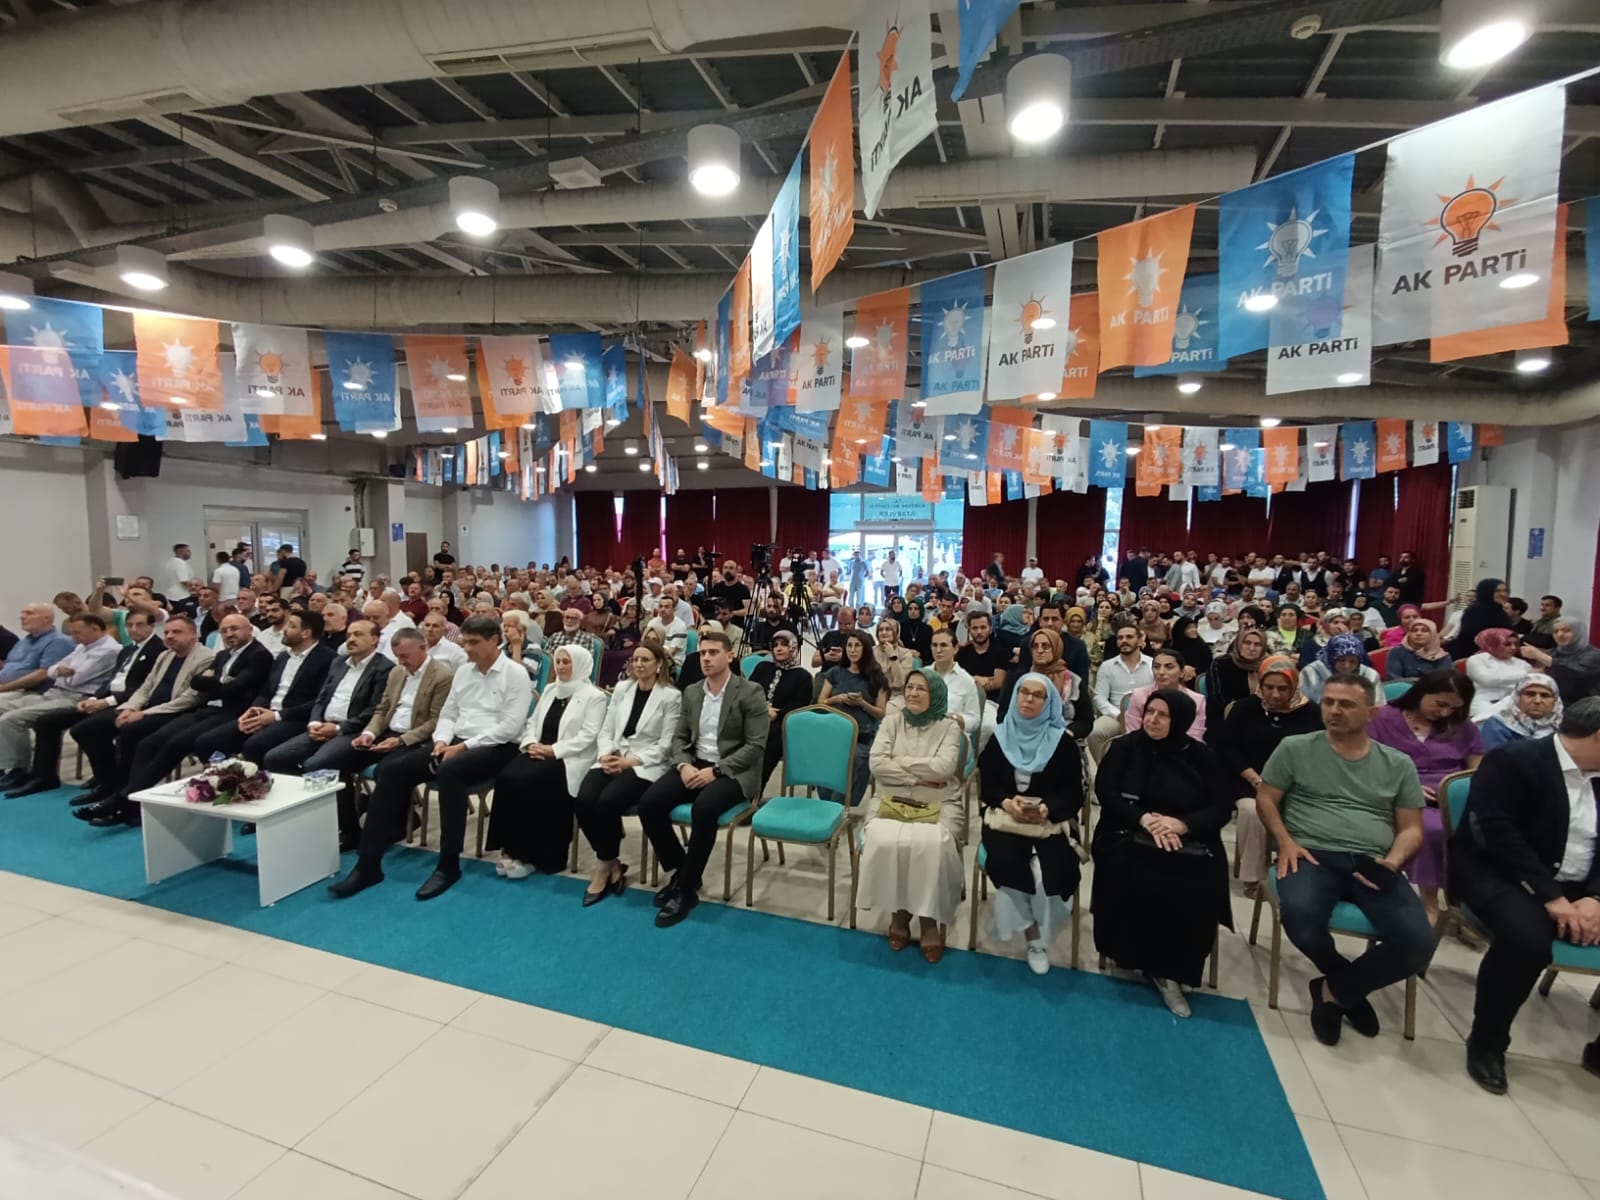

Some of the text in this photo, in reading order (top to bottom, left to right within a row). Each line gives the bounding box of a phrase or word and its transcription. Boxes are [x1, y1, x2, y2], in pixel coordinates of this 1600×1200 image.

[1391, 248, 1527, 296] AK PARTi
[1271, 272, 1333, 298] PARTi
[1109, 306, 1170, 330] AK PARTi
[927, 345, 977, 365] AK PARTi
[998, 343, 1055, 368] AK PARTi
[1170, 347, 1214, 364] PARTi
[1277, 337, 1359, 361] AK PARTi
[802, 374, 837, 390] AK PARTi
[1061, 366, 1089, 379] ARTi
